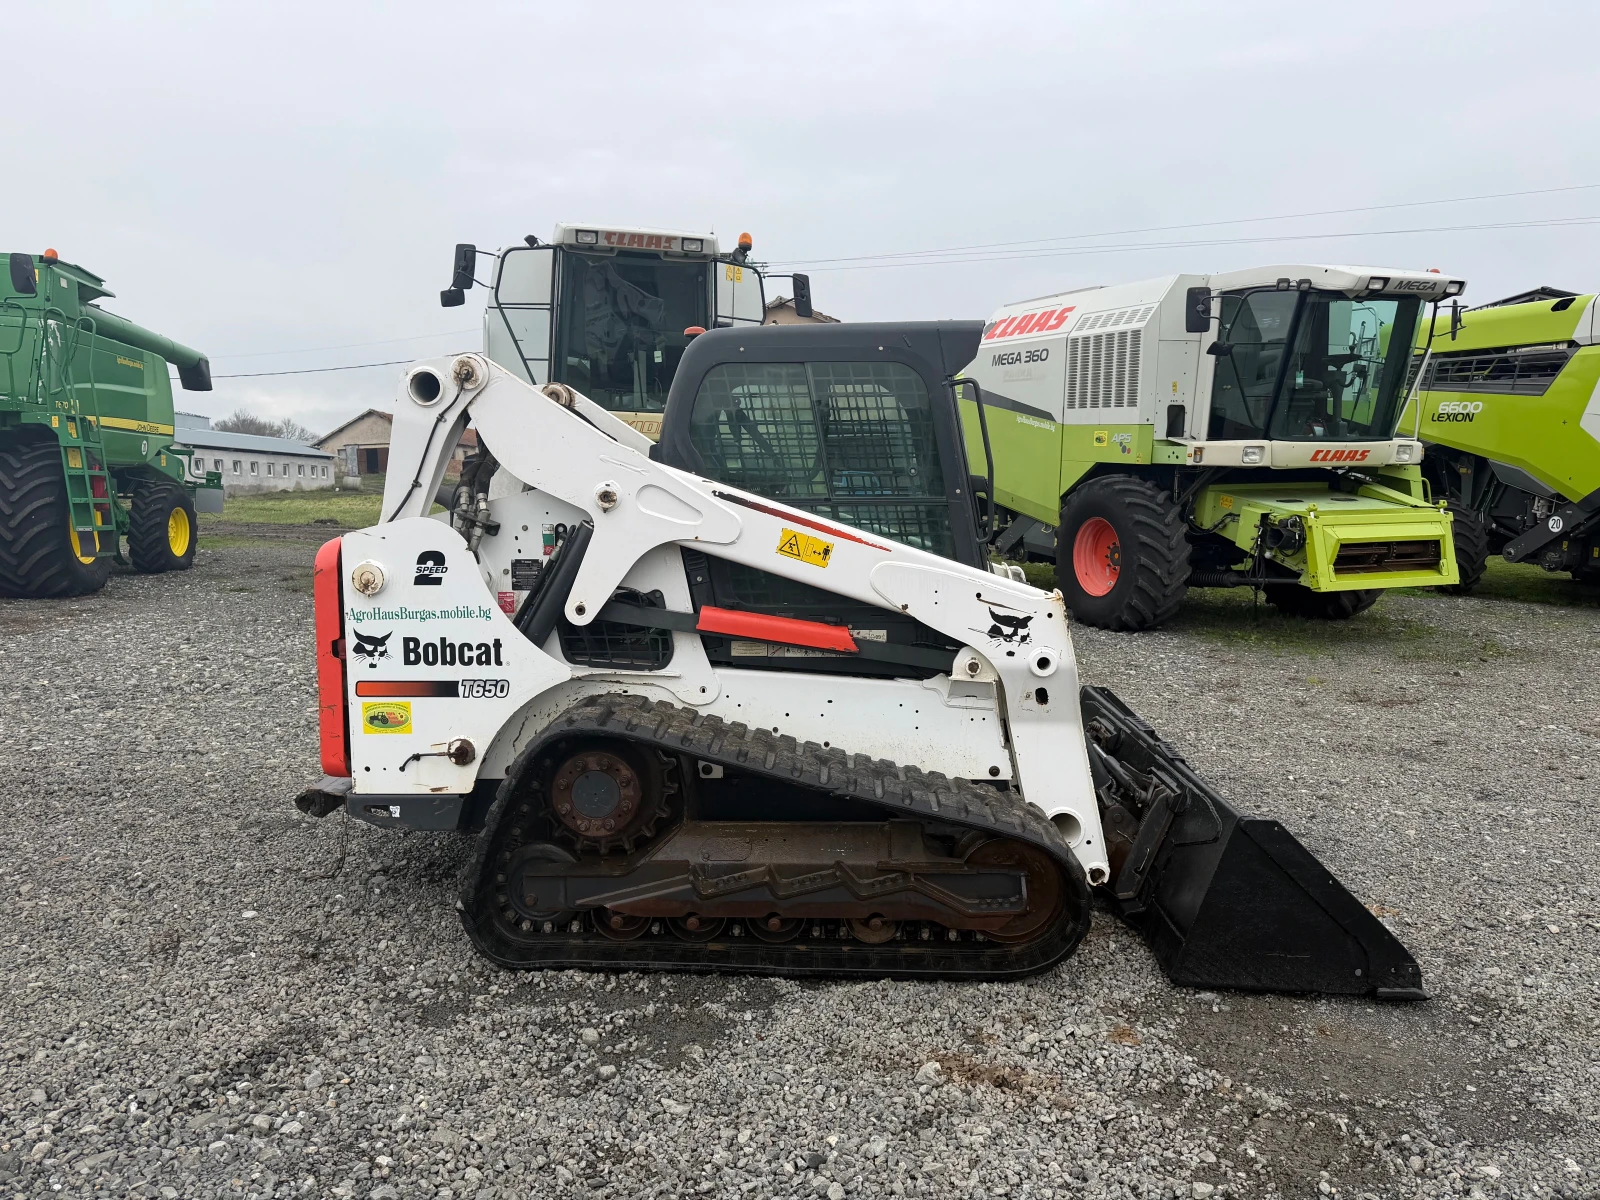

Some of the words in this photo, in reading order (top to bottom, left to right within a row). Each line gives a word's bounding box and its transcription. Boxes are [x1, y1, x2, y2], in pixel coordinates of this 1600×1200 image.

[604, 231, 678, 250] CLAAS
[1393, 280, 1438, 292] MEGA
[983, 305, 1077, 341] CLAAS
[991, 351, 1022, 367] MEGA
[1023, 347, 1050, 364] 360
[1438, 401, 1483, 414] 6600
[1431, 412, 1475, 423] LEXION
[1111, 433, 1132, 443] APS
[1309, 449, 1371, 462] CLAAS
[1551, 518, 1561, 530] 20
[413, 550, 446, 586] 2
[415, 566, 448, 574] SPEED
[348, 605, 492, 623] AgroHausBurgas.mobile.bg
[402, 636, 503, 667] Bobcat
[461, 679, 510, 699] T650
